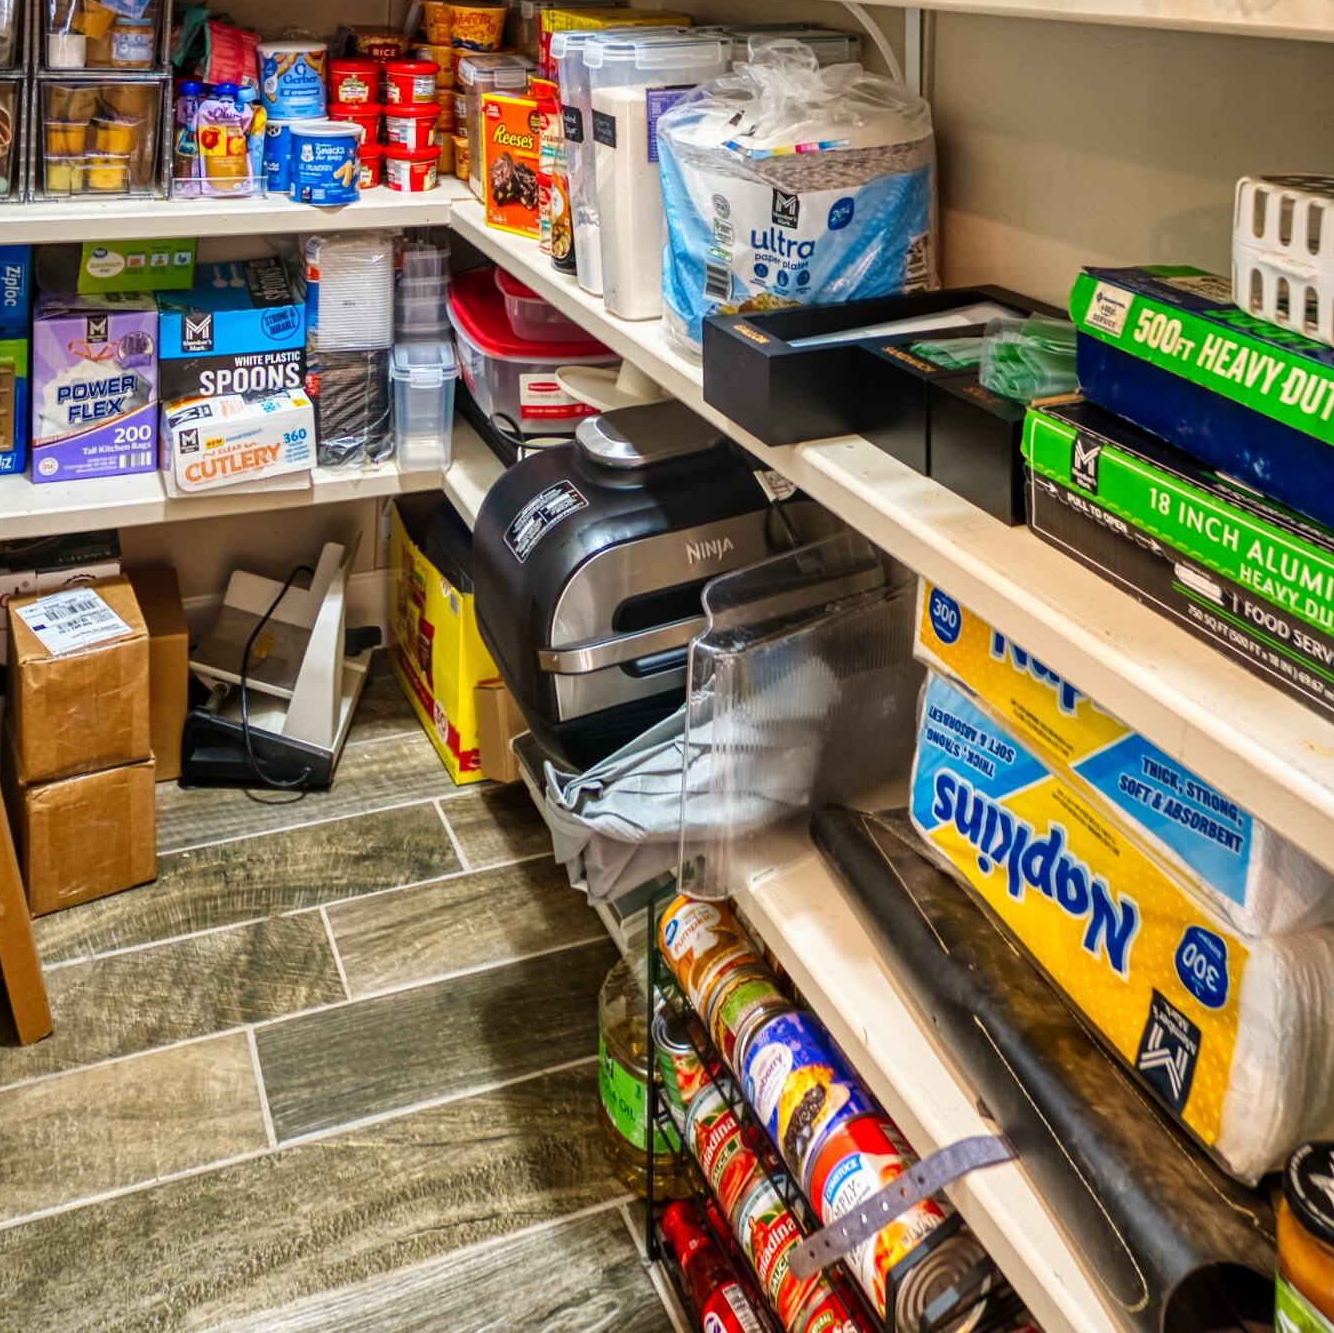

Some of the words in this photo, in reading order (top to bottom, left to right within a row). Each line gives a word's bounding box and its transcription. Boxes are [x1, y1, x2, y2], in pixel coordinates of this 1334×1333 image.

[373, 48, 396, 57] RICE
[283, 73, 317, 85] Gerber
[315, 146, 345, 155] Snacks
[493, 124, 535, 150] Reese's
[750, 226, 816, 260] ultra
[754, 252, 781, 265] paper
[1, 266, 21, 307] Ziploc
[235, 355, 264, 367] WHITE
[265, 351, 301, 365] PLASTIC
[1133, 307, 1196, 362] 500FT
[1196, 333, 1286, 395] HEAVY
[57, 375, 137, 405] POWER
[199, 363, 300, 396] SPOONS
[68, 397, 125, 423] FLEX
[83, 446, 97, 456] Tall
[98, 443, 130, 454] Kitchen
[131, 441, 152, 452] Bags
[114, 424, 152, 444] 200
[218, 444, 242, 454] CLEAR
[283, 428, 307, 444] 360
[185, 442, 282, 483] CUTLERY
[1067, 492, 1088, 513] PULL
[1089, 503, 1102, 518] TO
[1103, 511, 1128, 535] OPEN
[1149, 487, 1171, 516] 18
[1179, 502, 1239, 552] INCH
[685, 534, 735, 565] NINJA
[1239, 563, 1300, 609] HEAVY
[933, 596, 958, 629] 300
[1244, 599, 1291, 639] FOOD
[927, 704, 977, 743] ABSORBENT
[926, 727, 960, 758] STRONG
[986, 735, 1016, 766] SOFT
[1142, 754, 1184, 795] THICK,
[1186, 778, 1244, 828] STRONG,
[1119, 774, 1150, 803] SOFT
[1151, 791, 1162, 809] &
[1163, 797, 1244, 854] ABSORBENT
[935, 772, 1135, 974] Napkins
[674, 912, 715, 953] Pumpkin
[1182, 942, 1220, 992] 300
[619, 1099, 635, 1122] OIL
[825, 1156, 860, 1198] COMSTOCK
